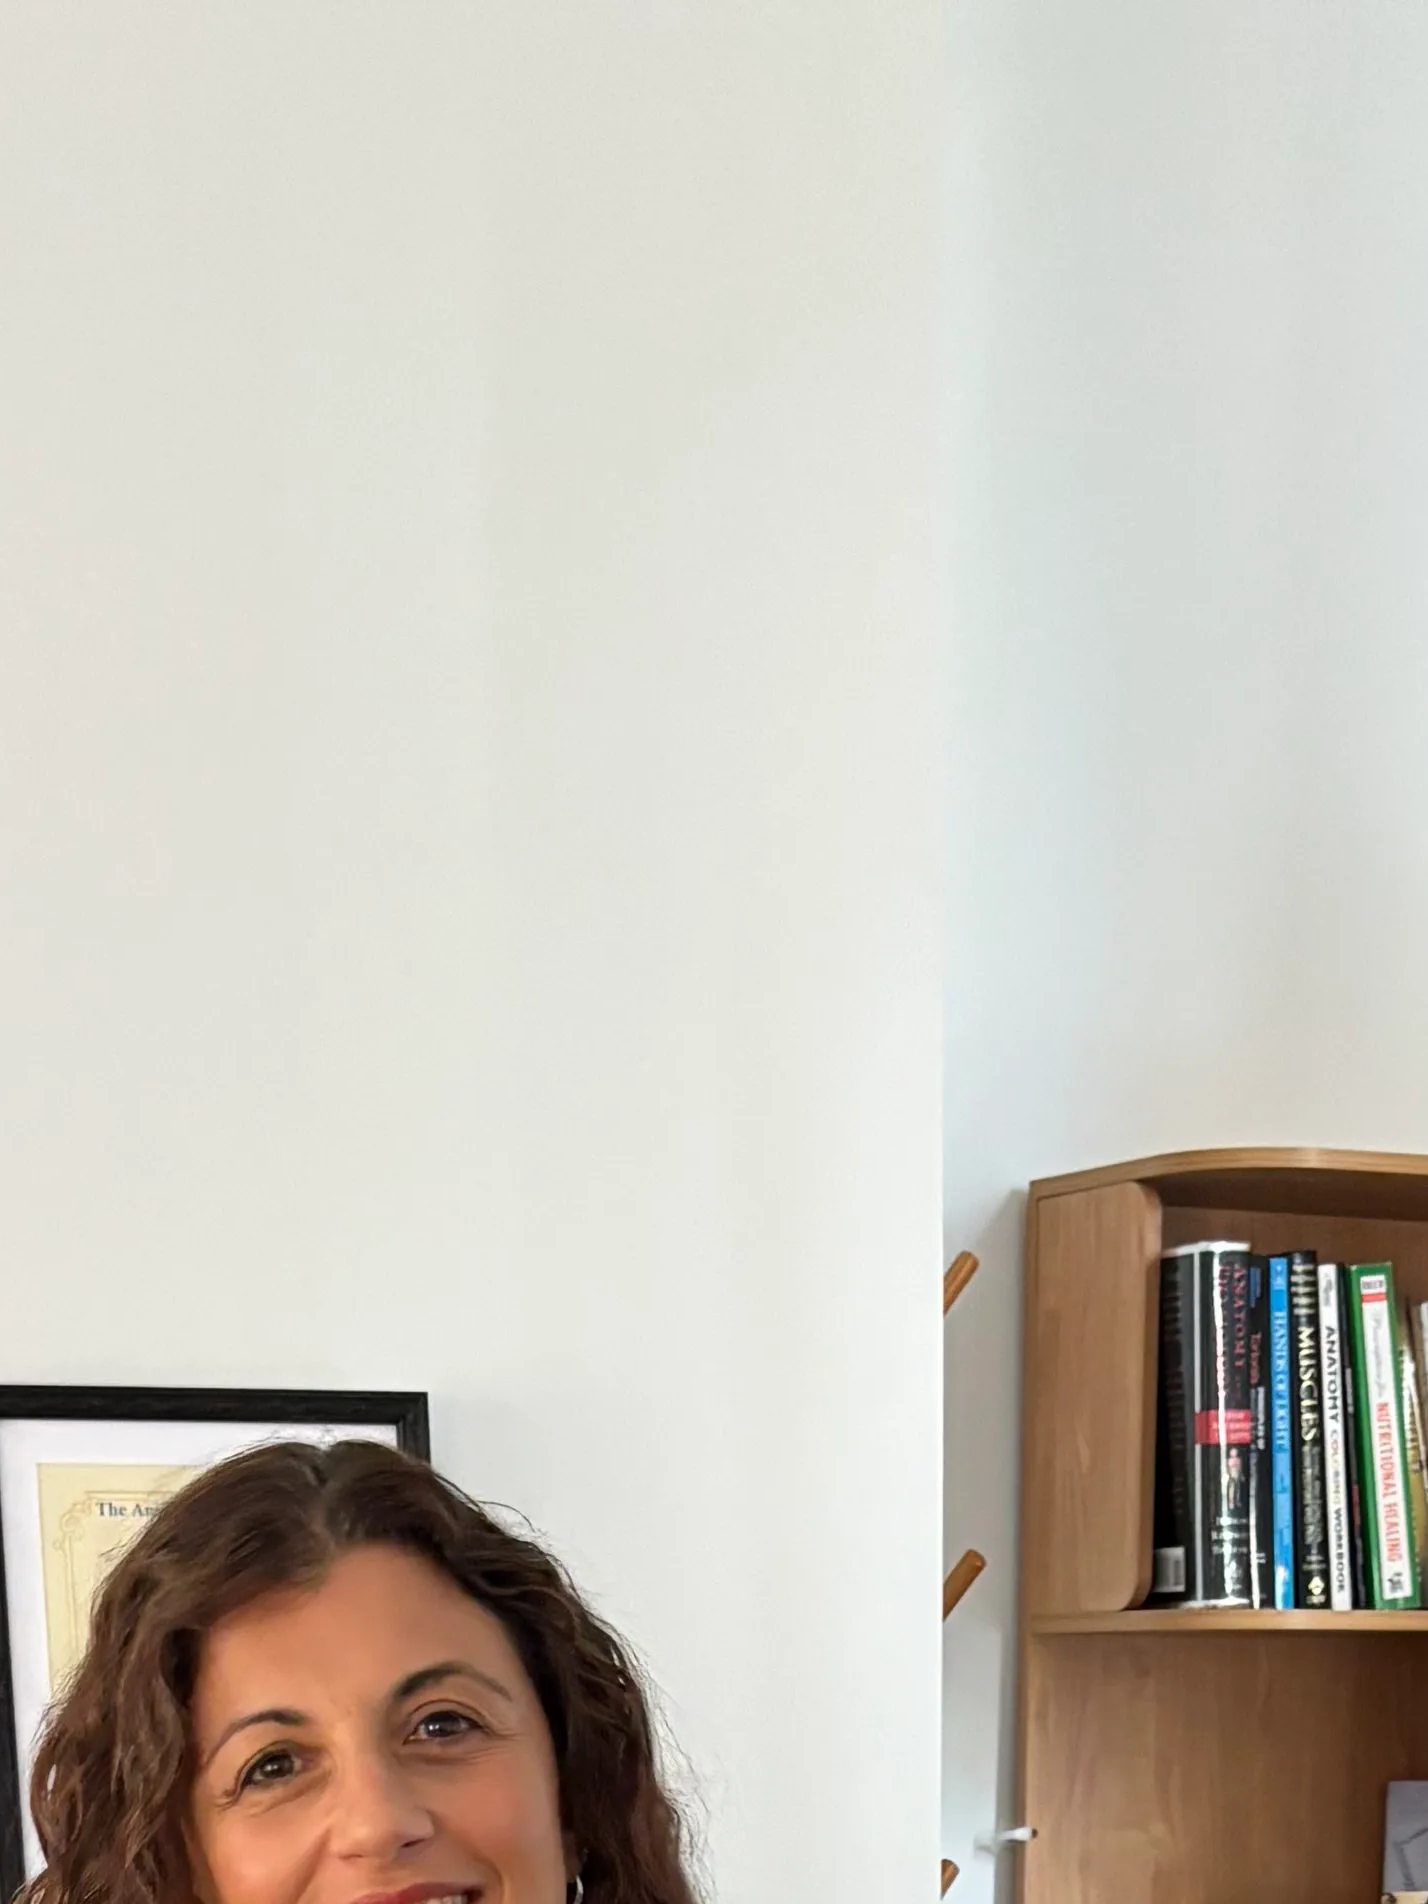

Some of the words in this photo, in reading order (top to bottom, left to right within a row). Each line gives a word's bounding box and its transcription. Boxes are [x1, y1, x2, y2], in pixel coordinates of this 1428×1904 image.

[1233, 1264, 1246, 1368] ANATOMY
[1298, 1326, 1319, 1441] MUSCLES
[1325, 1326, 1340, 1423] ANATOMY
[1333, 1508, 1346, 1593] WORKBOOK
[1376, 1402, 1397, 1499] NUTRITIONAL
[95, 1502, 127, 1516] The
[1384, 1501, 1403, 1562] HEALING
